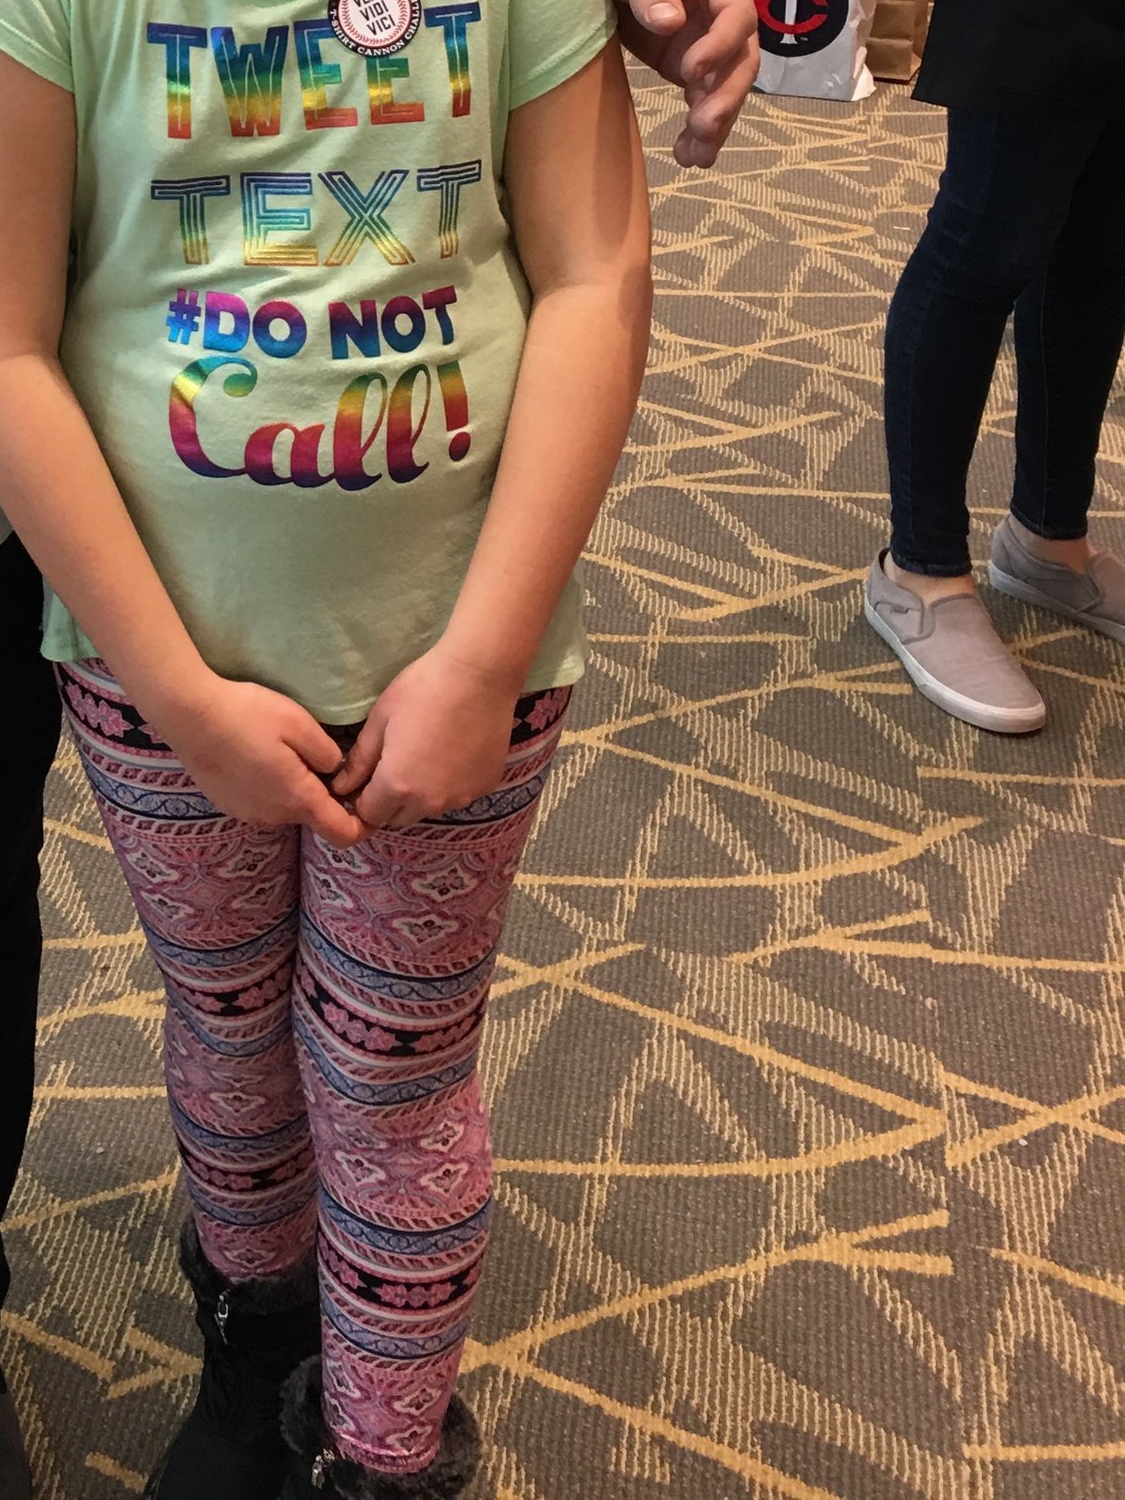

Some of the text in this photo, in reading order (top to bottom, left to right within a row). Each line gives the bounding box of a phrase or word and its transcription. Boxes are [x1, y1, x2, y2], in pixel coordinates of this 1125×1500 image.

[329, 10, 357, 49] T-SHIRT
[357, 39, 405, 56] CANNON
[359, 0, 389, 22] VIDI
[366, 15, 396, 36] VICI
[146, 0, 482, 139] TWEET
[150, 158, 482, 267] TEXT
[165, 285, 458, 360] #DO NOT
[168, 355, 471, 492] Call!
